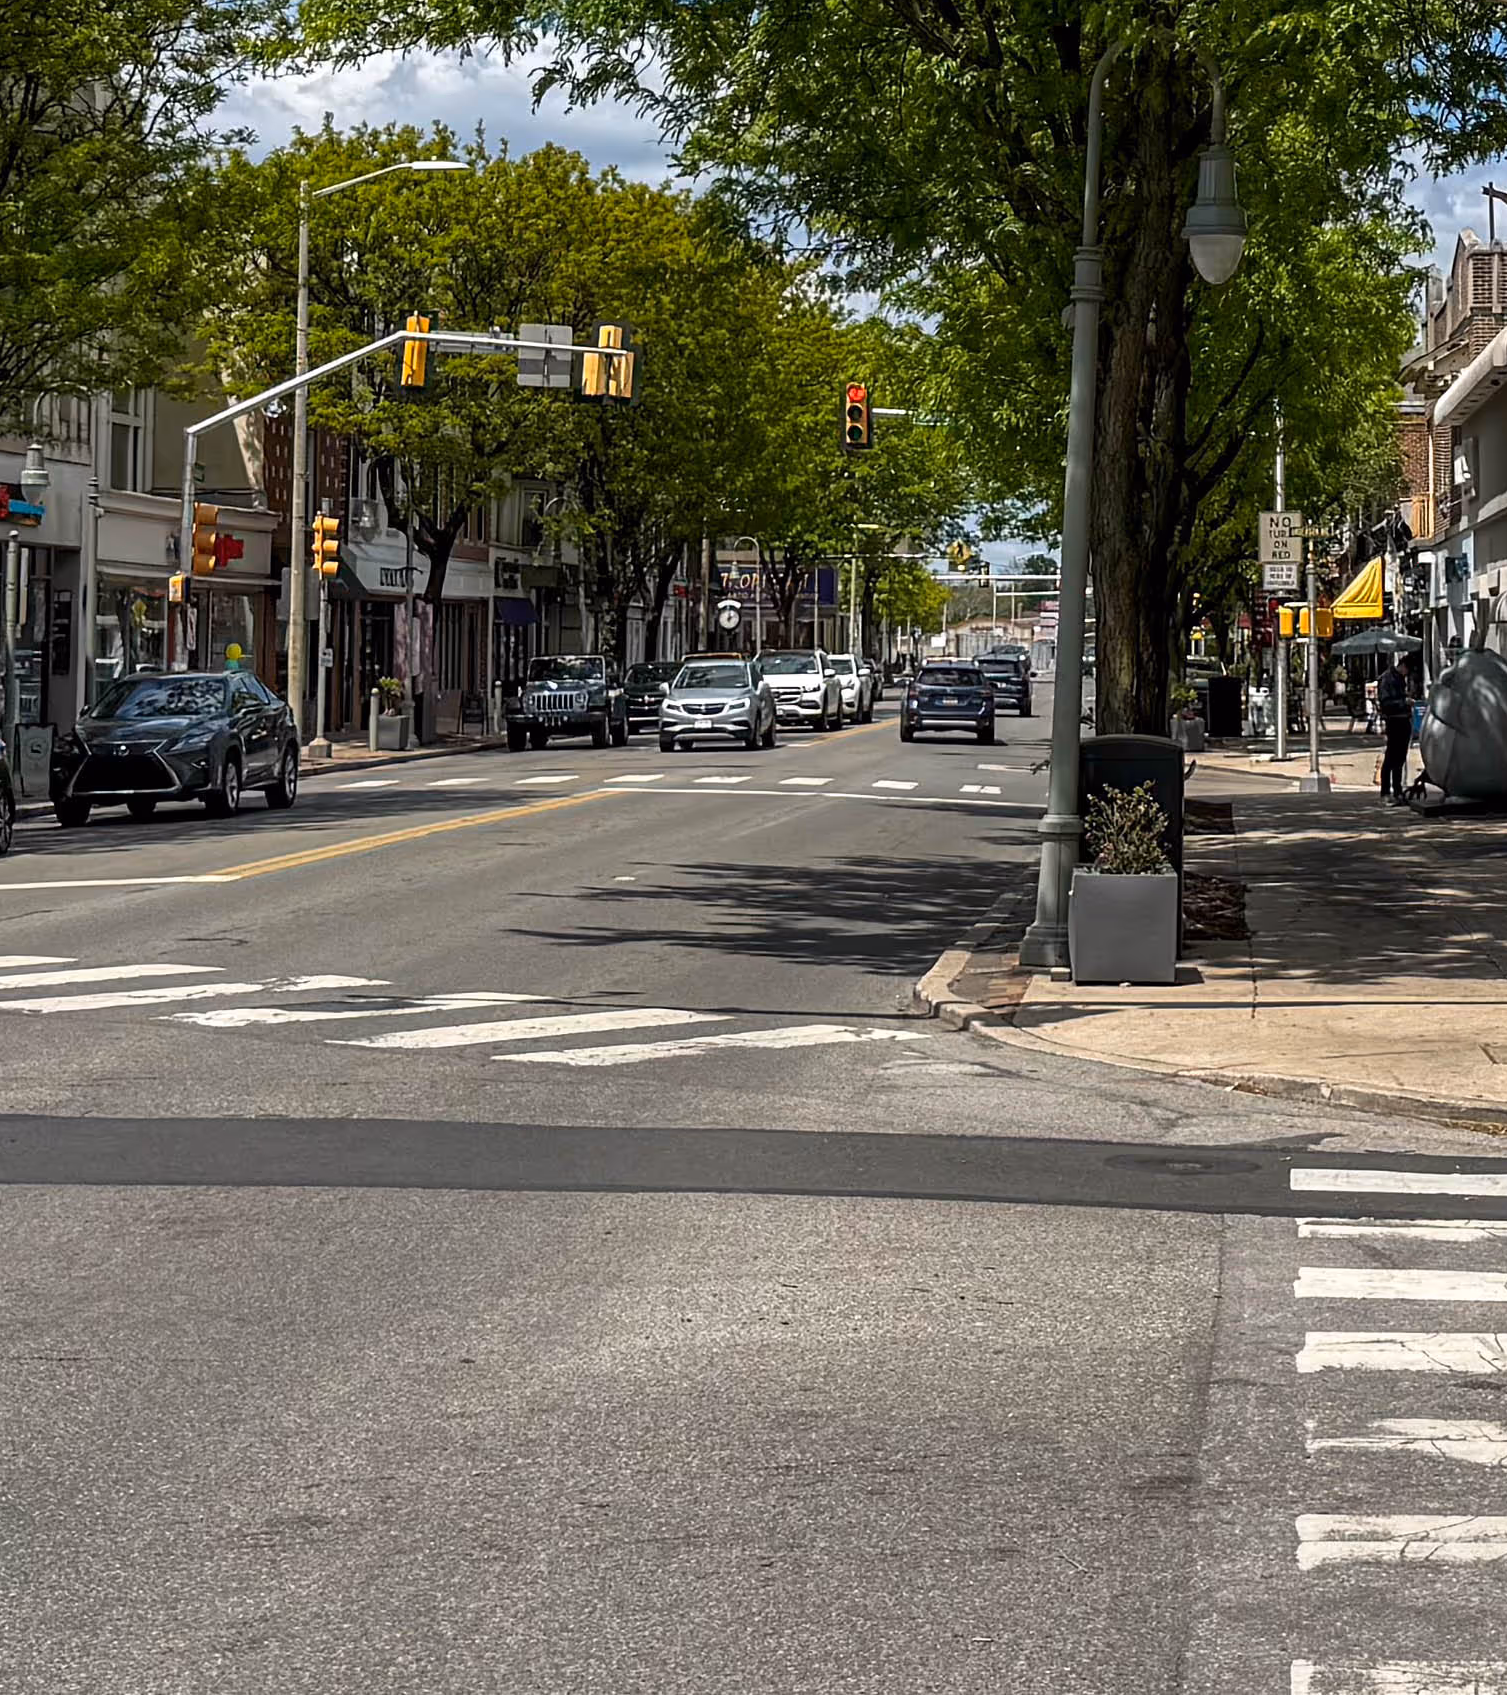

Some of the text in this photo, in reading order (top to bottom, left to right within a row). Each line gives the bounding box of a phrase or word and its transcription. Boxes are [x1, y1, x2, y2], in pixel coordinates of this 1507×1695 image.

[1269, 516, 1292, 528] NO
[1269, 529, 1287, 539] TUR
[1272, 551, 1291, 560] RED
